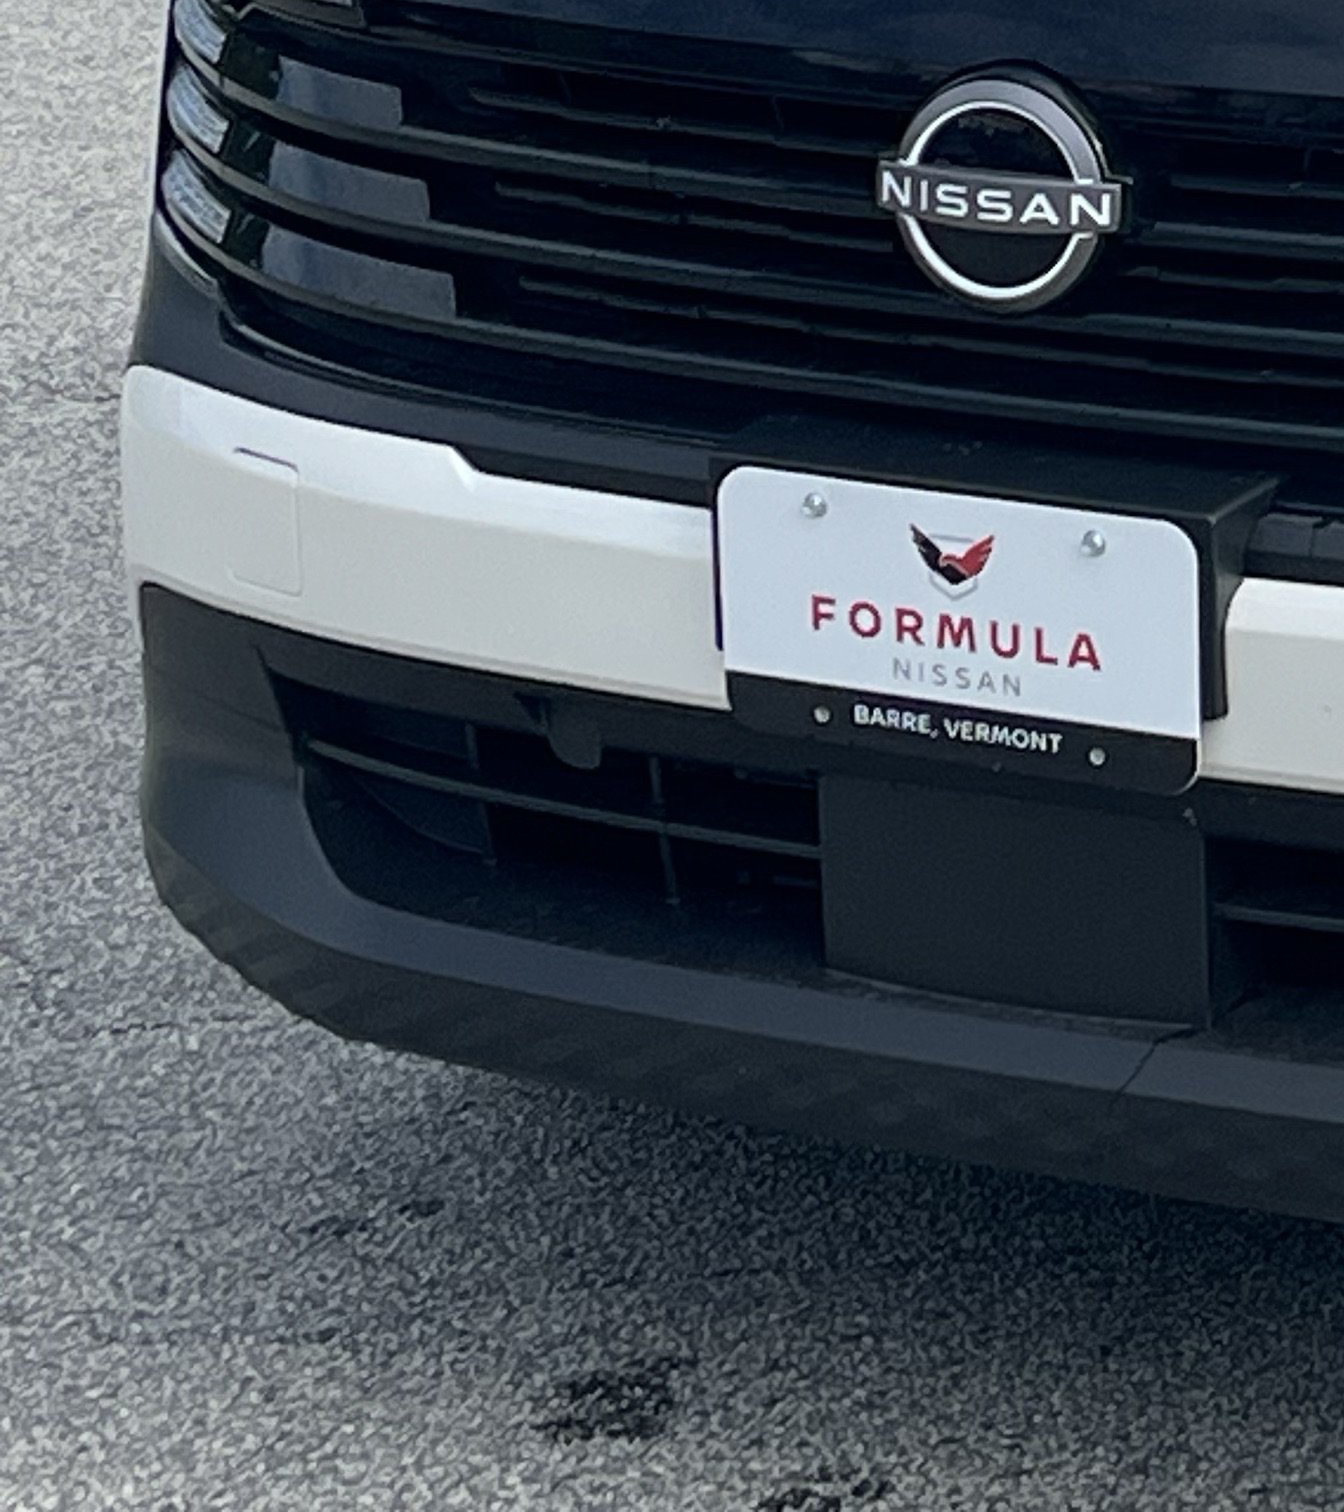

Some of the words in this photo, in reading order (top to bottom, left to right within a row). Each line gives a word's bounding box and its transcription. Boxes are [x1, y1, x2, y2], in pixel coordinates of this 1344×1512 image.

[881, 170, 1112, 227] NISSAN
[810, 593, 1102, 672] FORMULA
[891, 655, 1023, 698] NISSAN
[853, 702, 939, 739] BARRE,
[943, 717, 1063, 755] VERMONT
